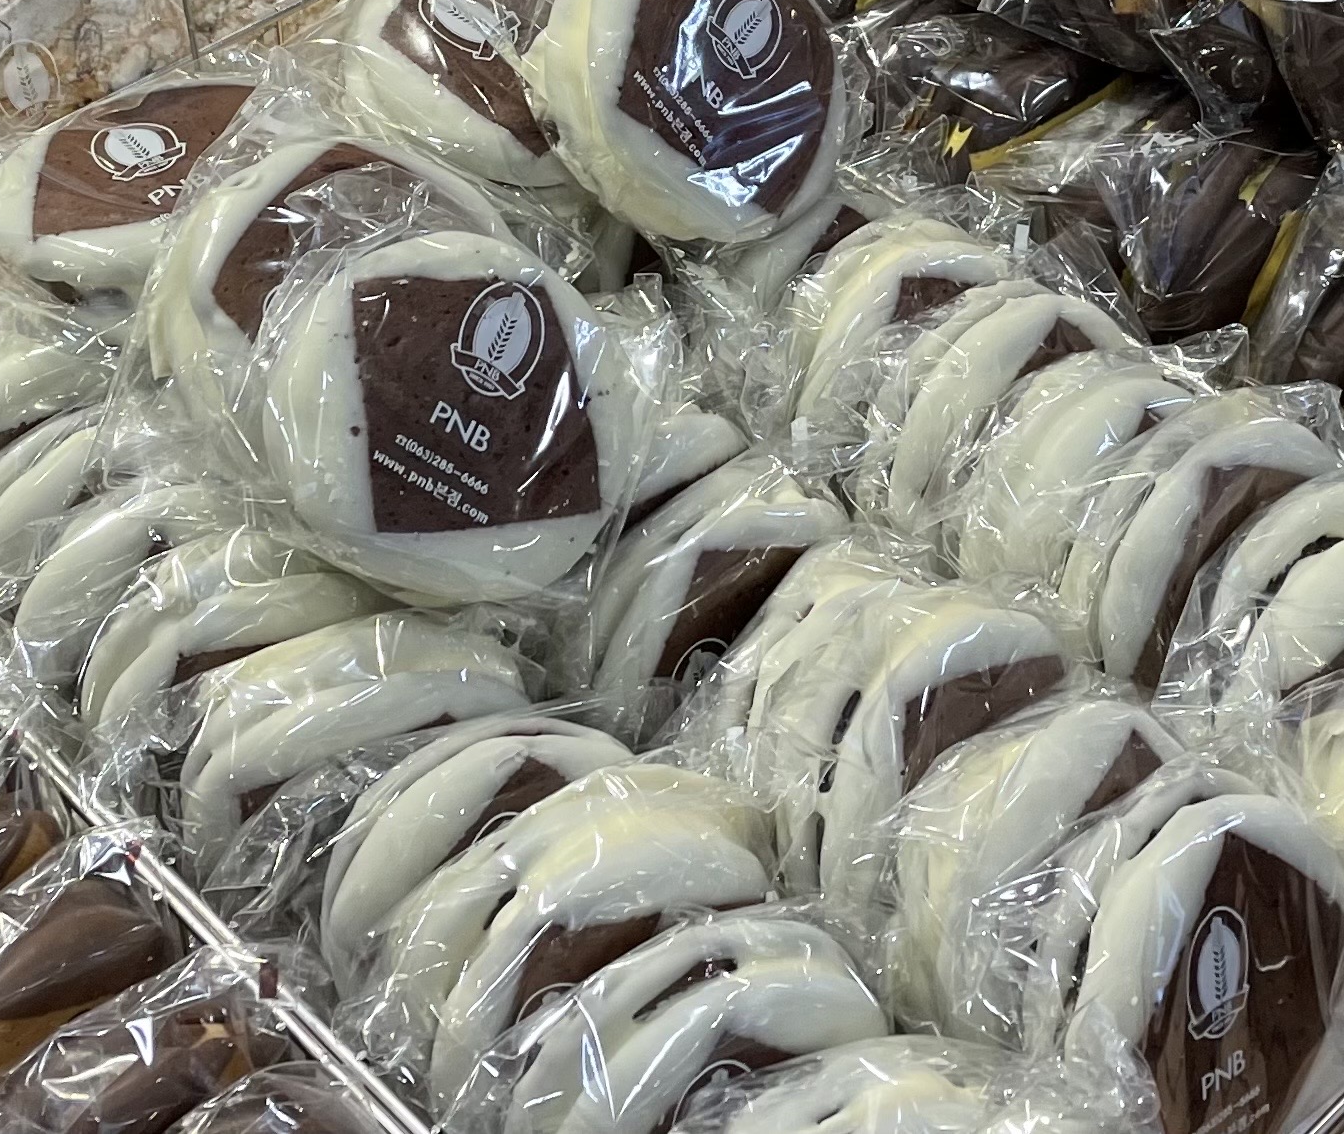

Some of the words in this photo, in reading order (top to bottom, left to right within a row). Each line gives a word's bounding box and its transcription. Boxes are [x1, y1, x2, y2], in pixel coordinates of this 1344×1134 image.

[474, 358, 500, 382] PNB
[429, 400, 491, 453] PNB
[1200, 1049, 1247, 1102] PNB
